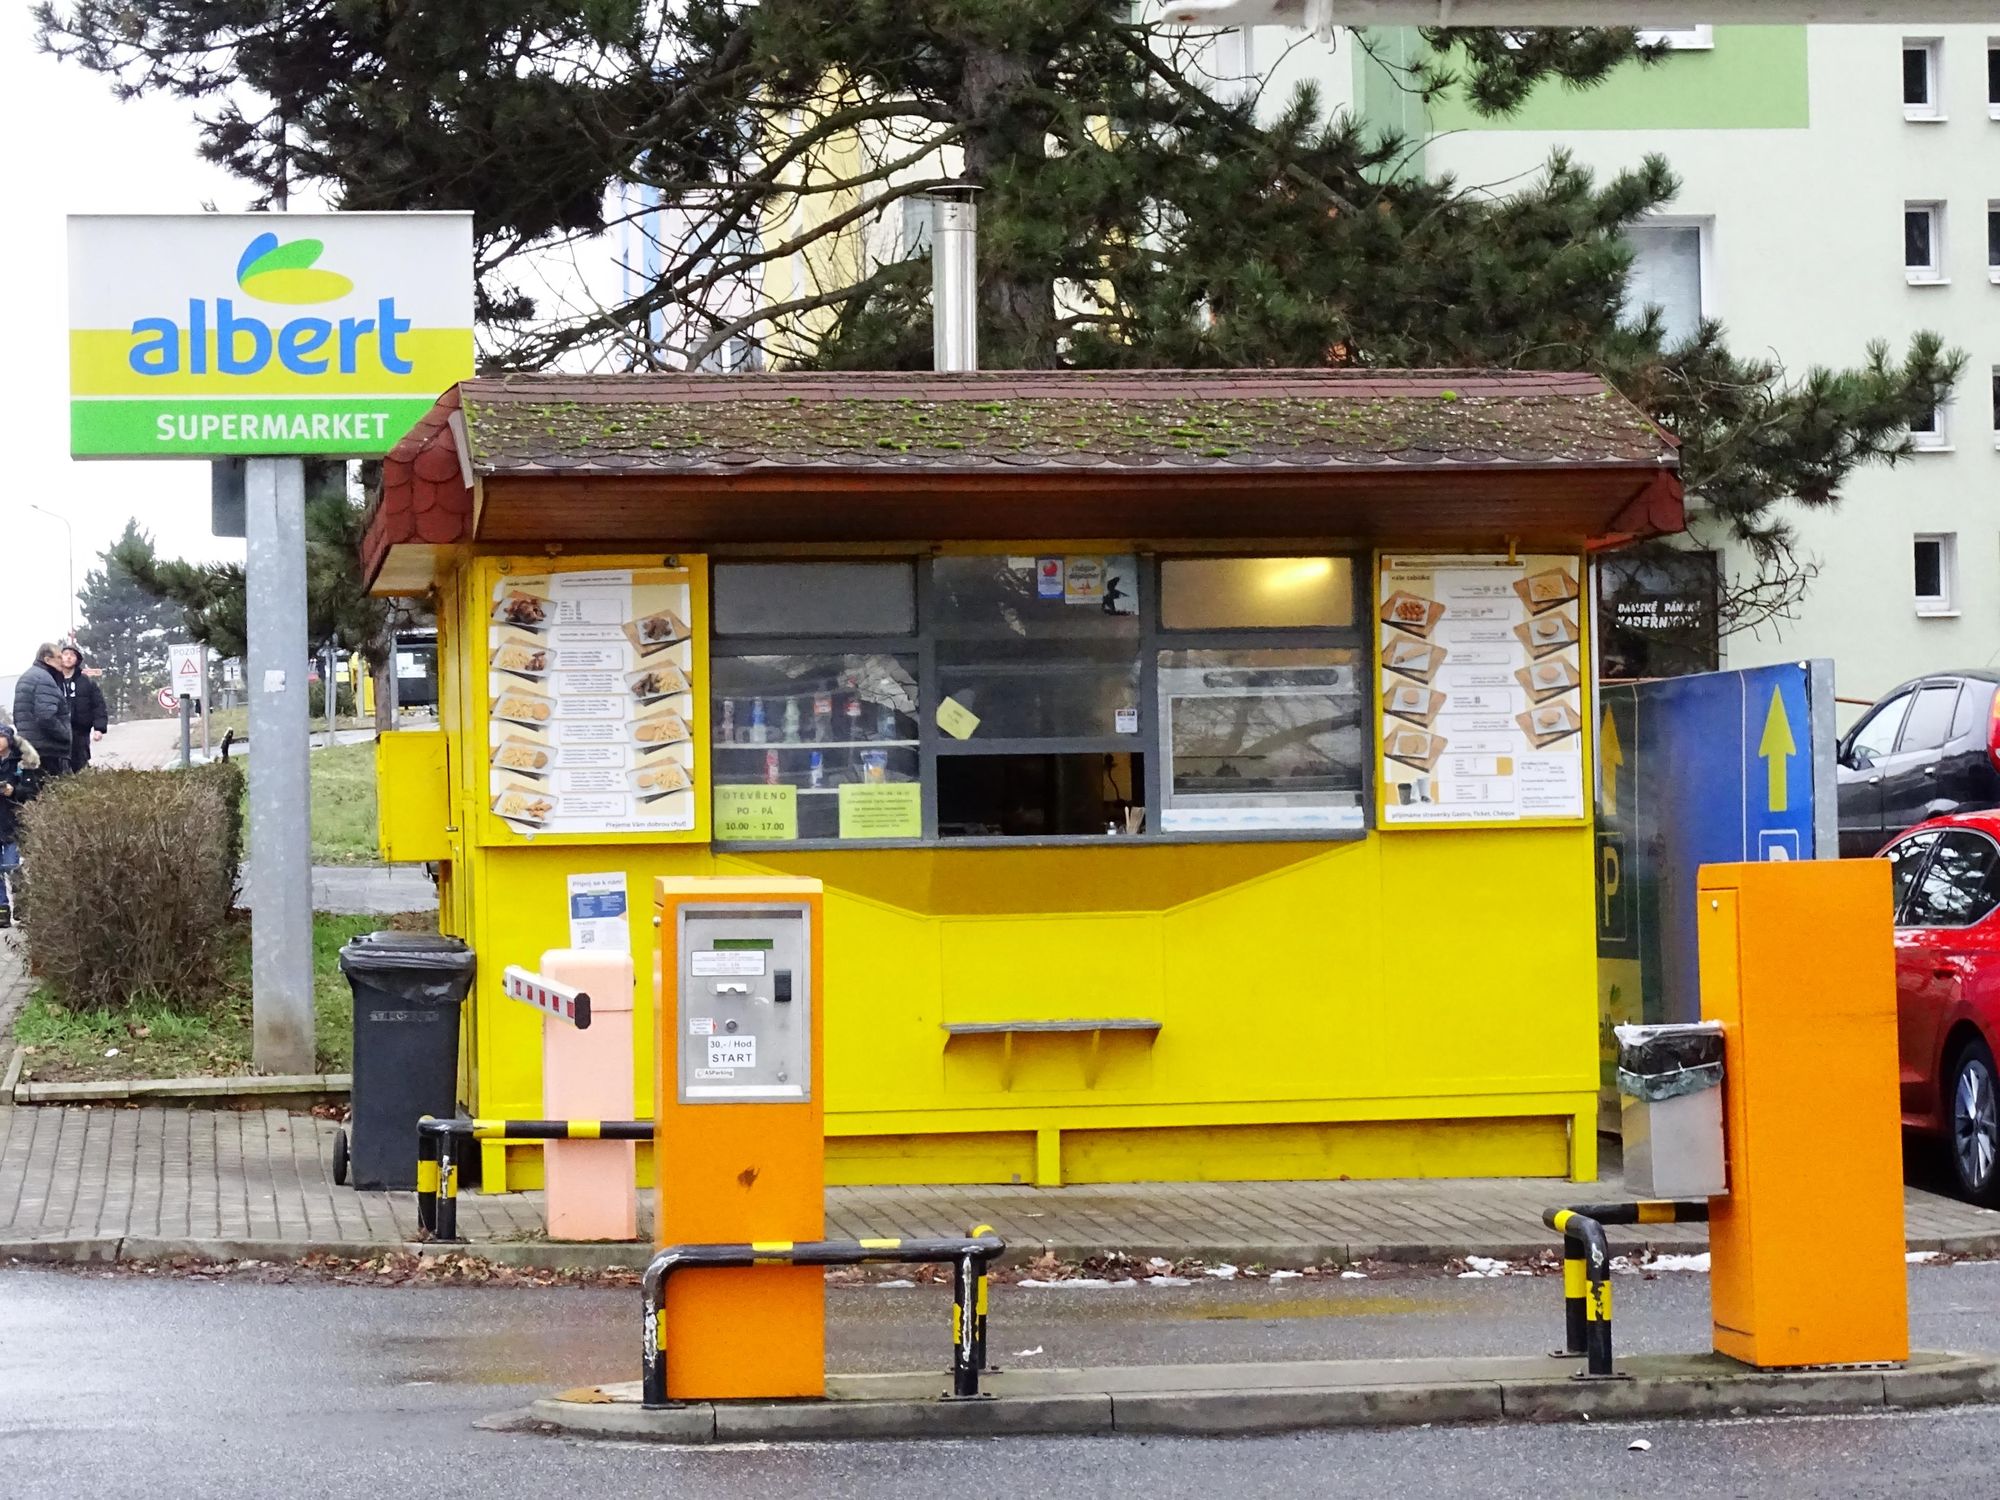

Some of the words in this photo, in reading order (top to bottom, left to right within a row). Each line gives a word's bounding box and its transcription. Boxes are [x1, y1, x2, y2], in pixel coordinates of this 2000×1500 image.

[129, 297, 413, 375] albert
[156, 413, 389, 441] SUPERMARKET
[722, 791, 787, 800] OTEVŘENO
[736, 807, 750, 815] PO
[761, 806, 773, 815] PÁ
[647, 820, 670, 828] dobrou
[725, 822, 750, 831] 10.00
[761, 822, 785, 831] 17.00
[1603, 846, 1620, 927] P
[734, 1040, 752, 1048] Hod
[711, 1053, 752, 1063] START
